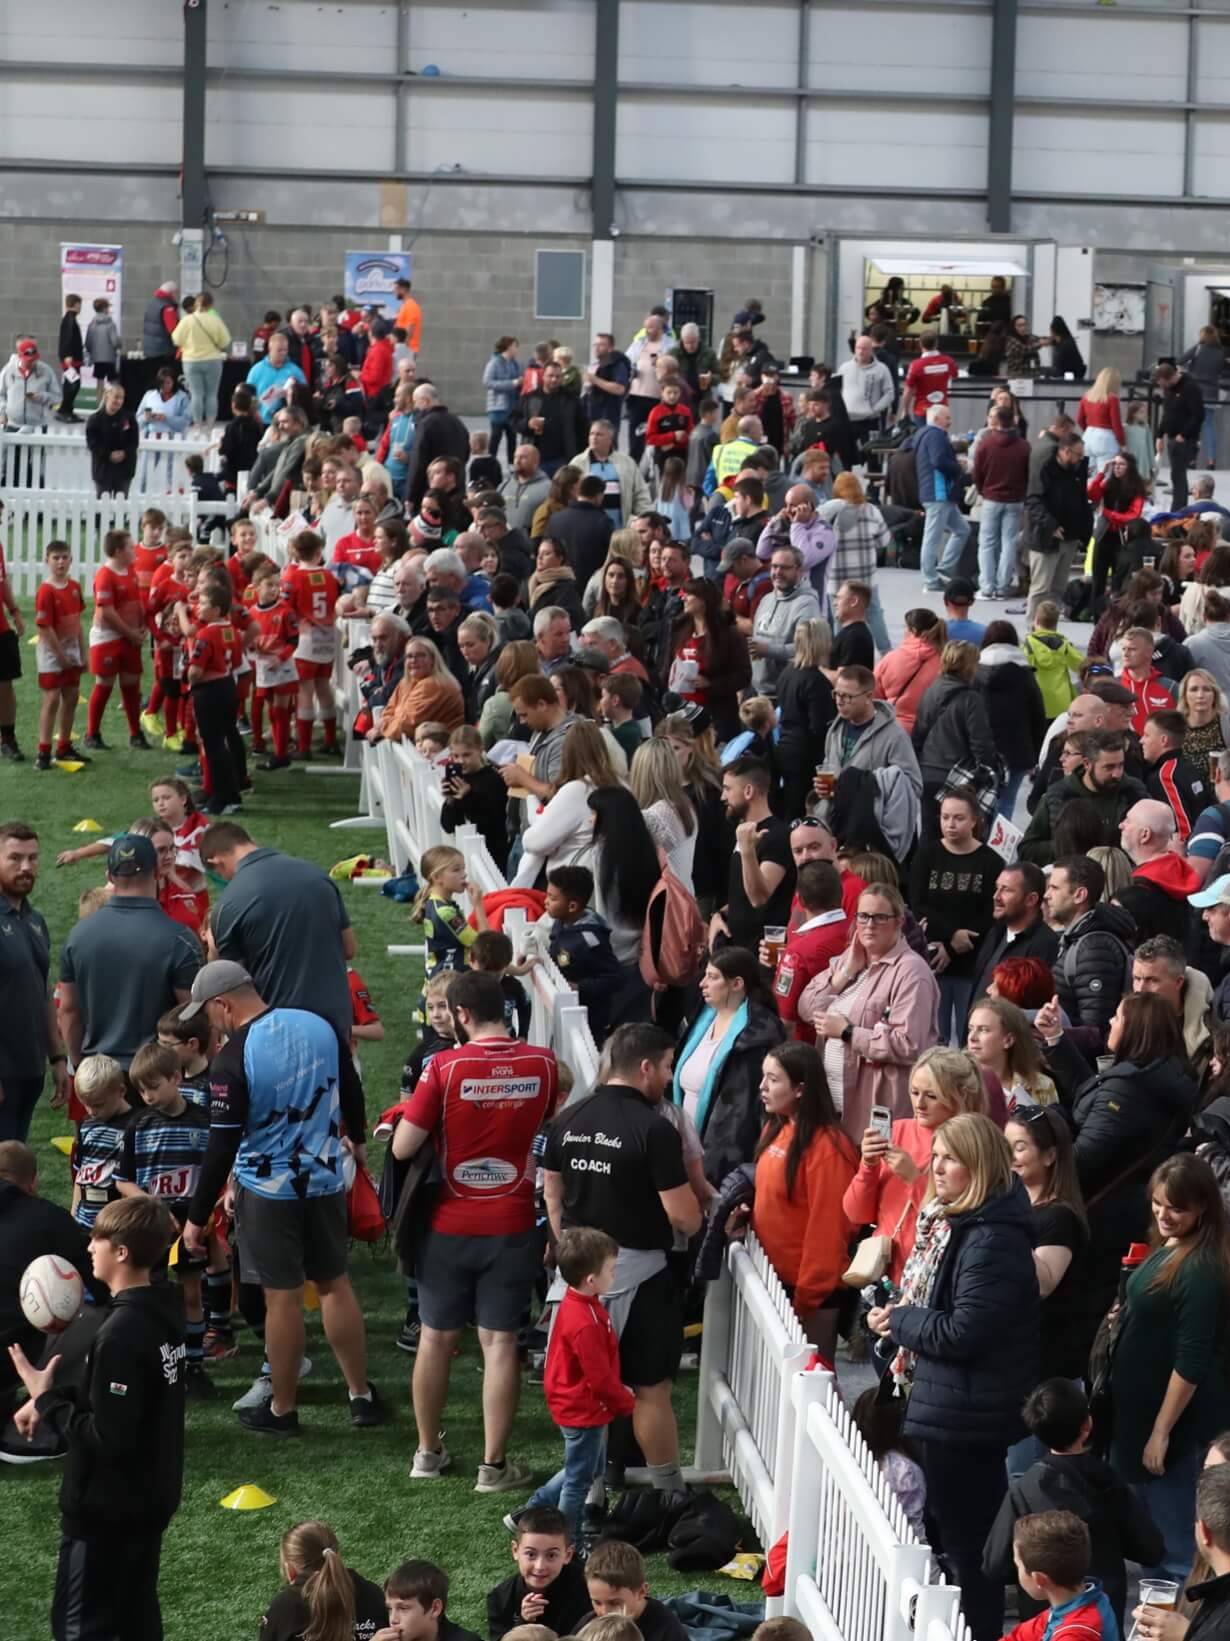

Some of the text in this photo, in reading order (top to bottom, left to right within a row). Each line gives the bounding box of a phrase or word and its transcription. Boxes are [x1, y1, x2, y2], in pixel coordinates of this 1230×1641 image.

[312, 591, 327, 619] 5
[928, 869, 983, 893] LOVE
[473, 1083, 538, 1095] INTERSPORT
[562, 1131, 591, 1146] Junior
[570, 1158, 612, 1175] COACH
